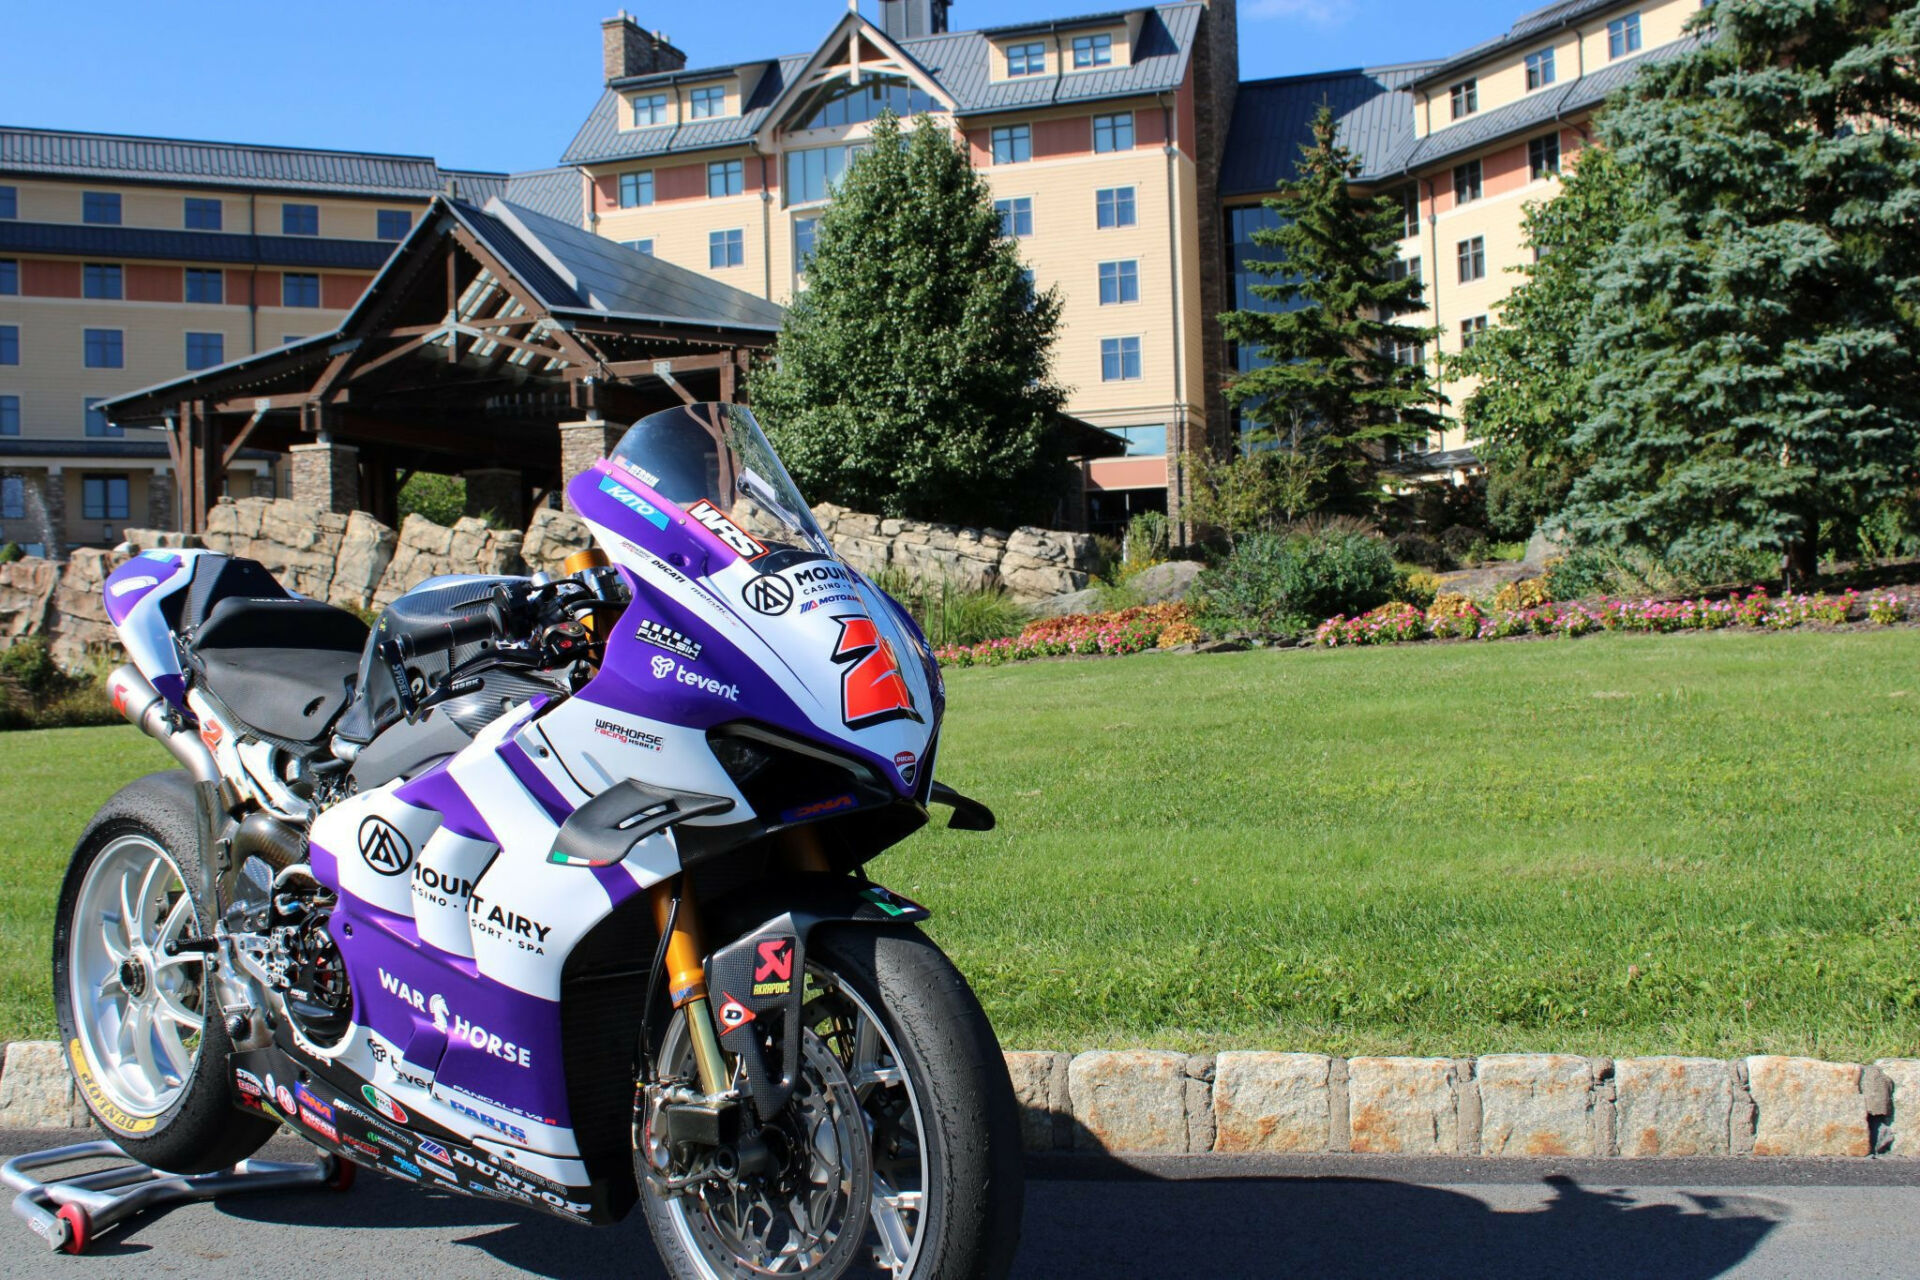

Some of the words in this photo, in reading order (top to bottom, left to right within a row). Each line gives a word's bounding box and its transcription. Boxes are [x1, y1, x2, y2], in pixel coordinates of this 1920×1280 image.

[606, 486, 655, 515] KATO
[689, 501, 765, 557] WRS
[651, 559, 686, 583] DUCATI
[803, 581, 841, 596] CASINO
[636, 627, 700, 658] FULLSIX
[392, 663, 409, 697] SPIDER
[676, 664, 740, 701] tevent
[594, 718, 664, 746] WARHORSE
[594, 727, 627, 744] racing
[410, 884, 448, 907] ASINO
[517, 940, 545, 956] SPA
[486, 902, 551, 943] AIRY
[378, 967, 425, 1013] WAR
[454, 1014, 531, 1068] HORSE
[81, 1072, 137, 1130] DUNLOP
[452, 1084, 524, 1116] PANIGALE
[524, 1110, 545, 1122] V4
[449, 1100, 528, 1140] PARTS
[452, 1149, 592, 1214] DUNLOP
